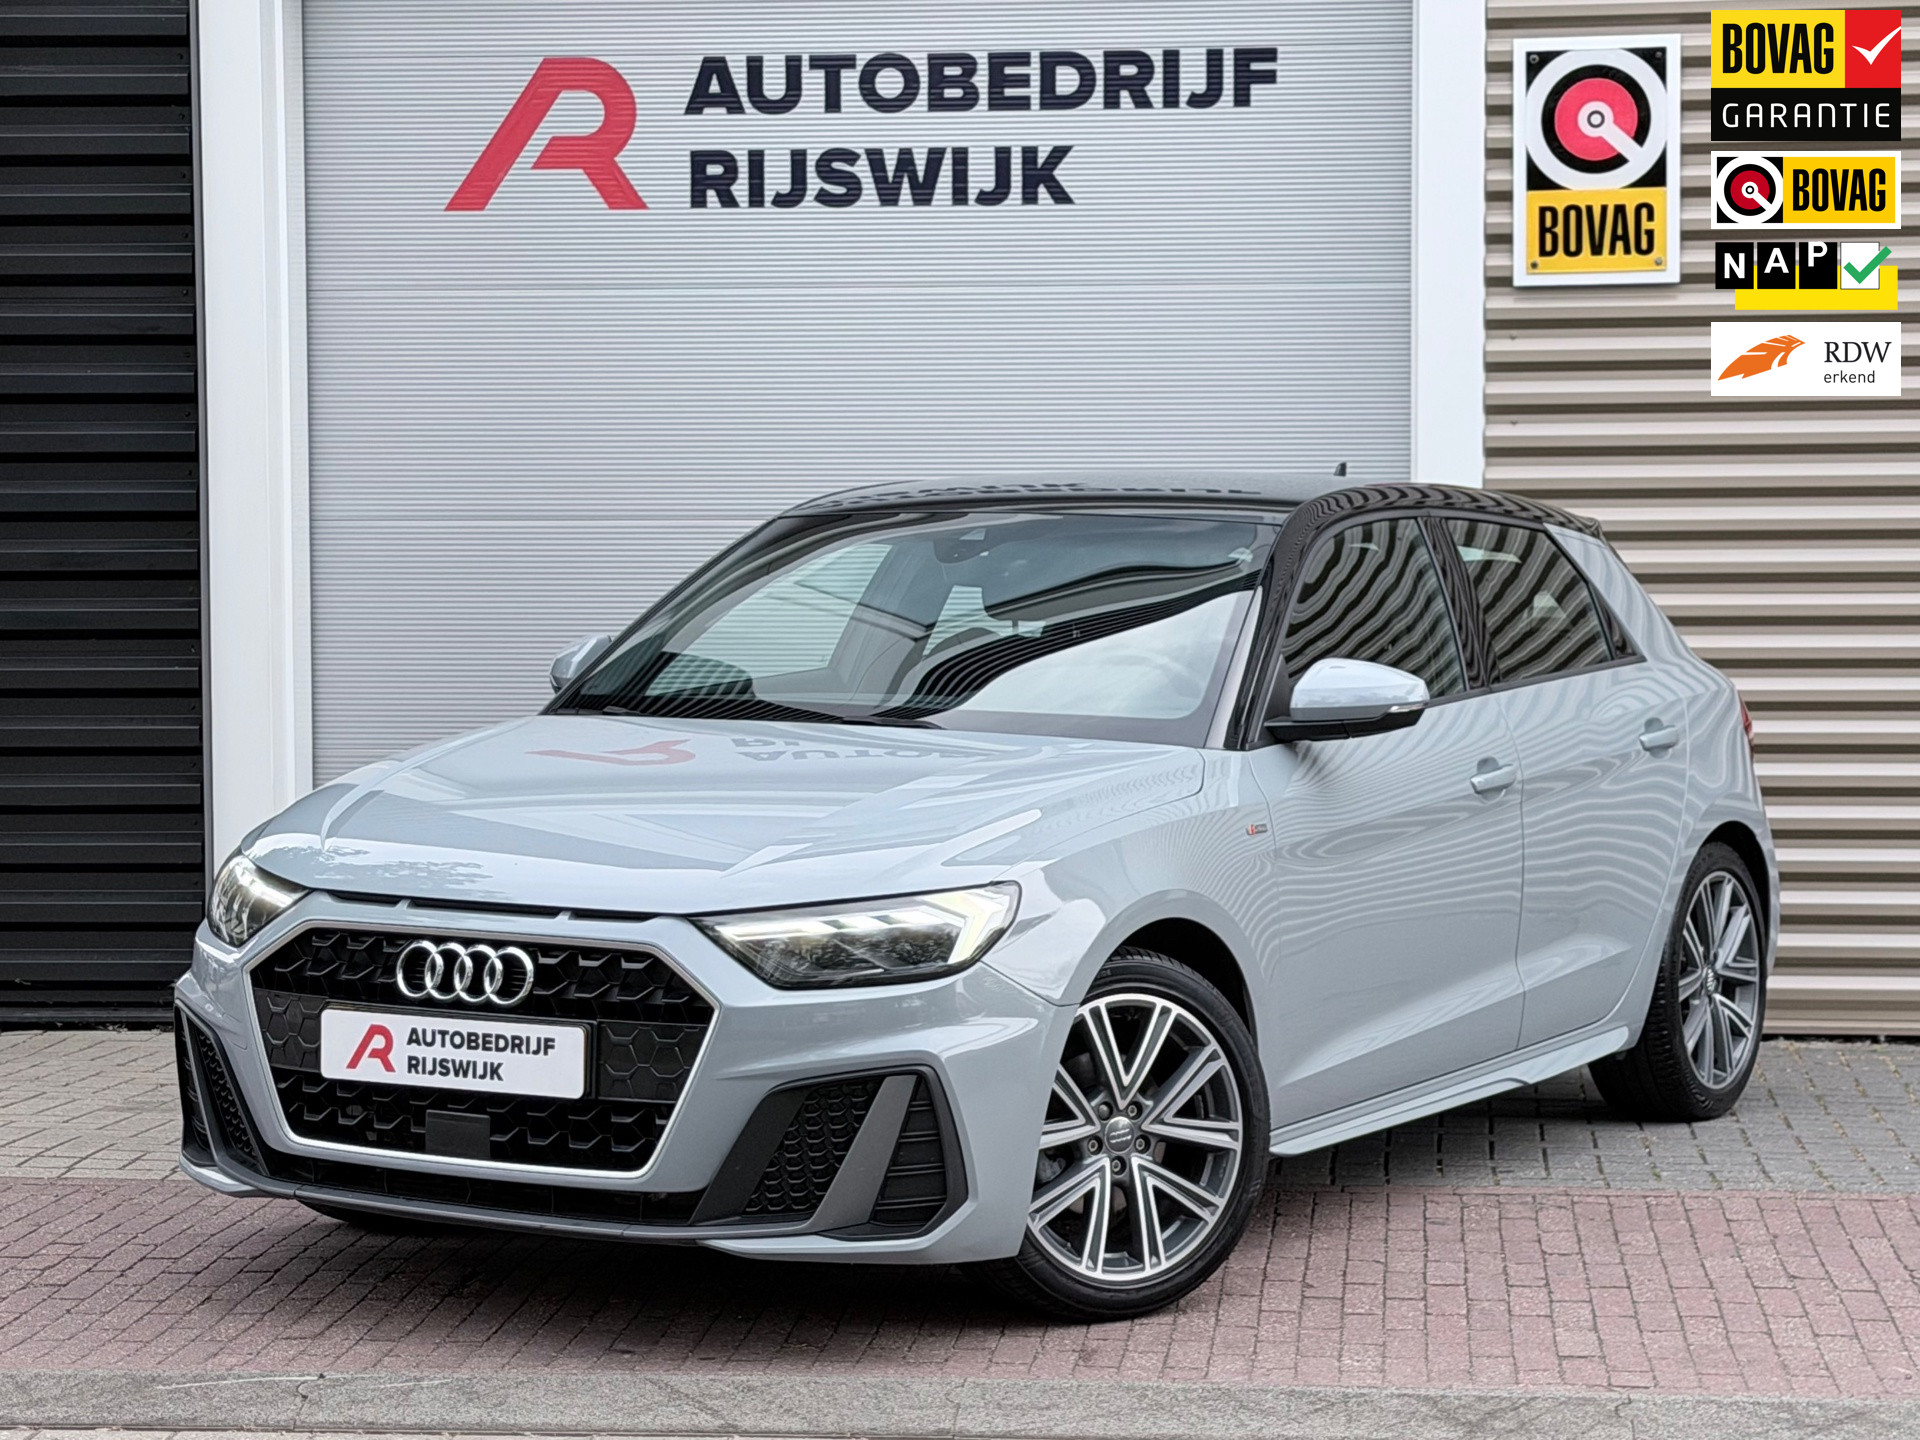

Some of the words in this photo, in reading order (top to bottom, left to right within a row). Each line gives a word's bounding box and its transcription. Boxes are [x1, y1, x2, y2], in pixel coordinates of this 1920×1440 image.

[684, 47, 1278, 116] AUTOBEDRIJF
[689, 145, 1075, 209] RIJSWIJK
[1538, 202, 1655, 258] BOVAG
[406, 1027, 556, 1057] AUTOBEDRIJF
[406, 1056, 504, 1082] RIJSWIJK
